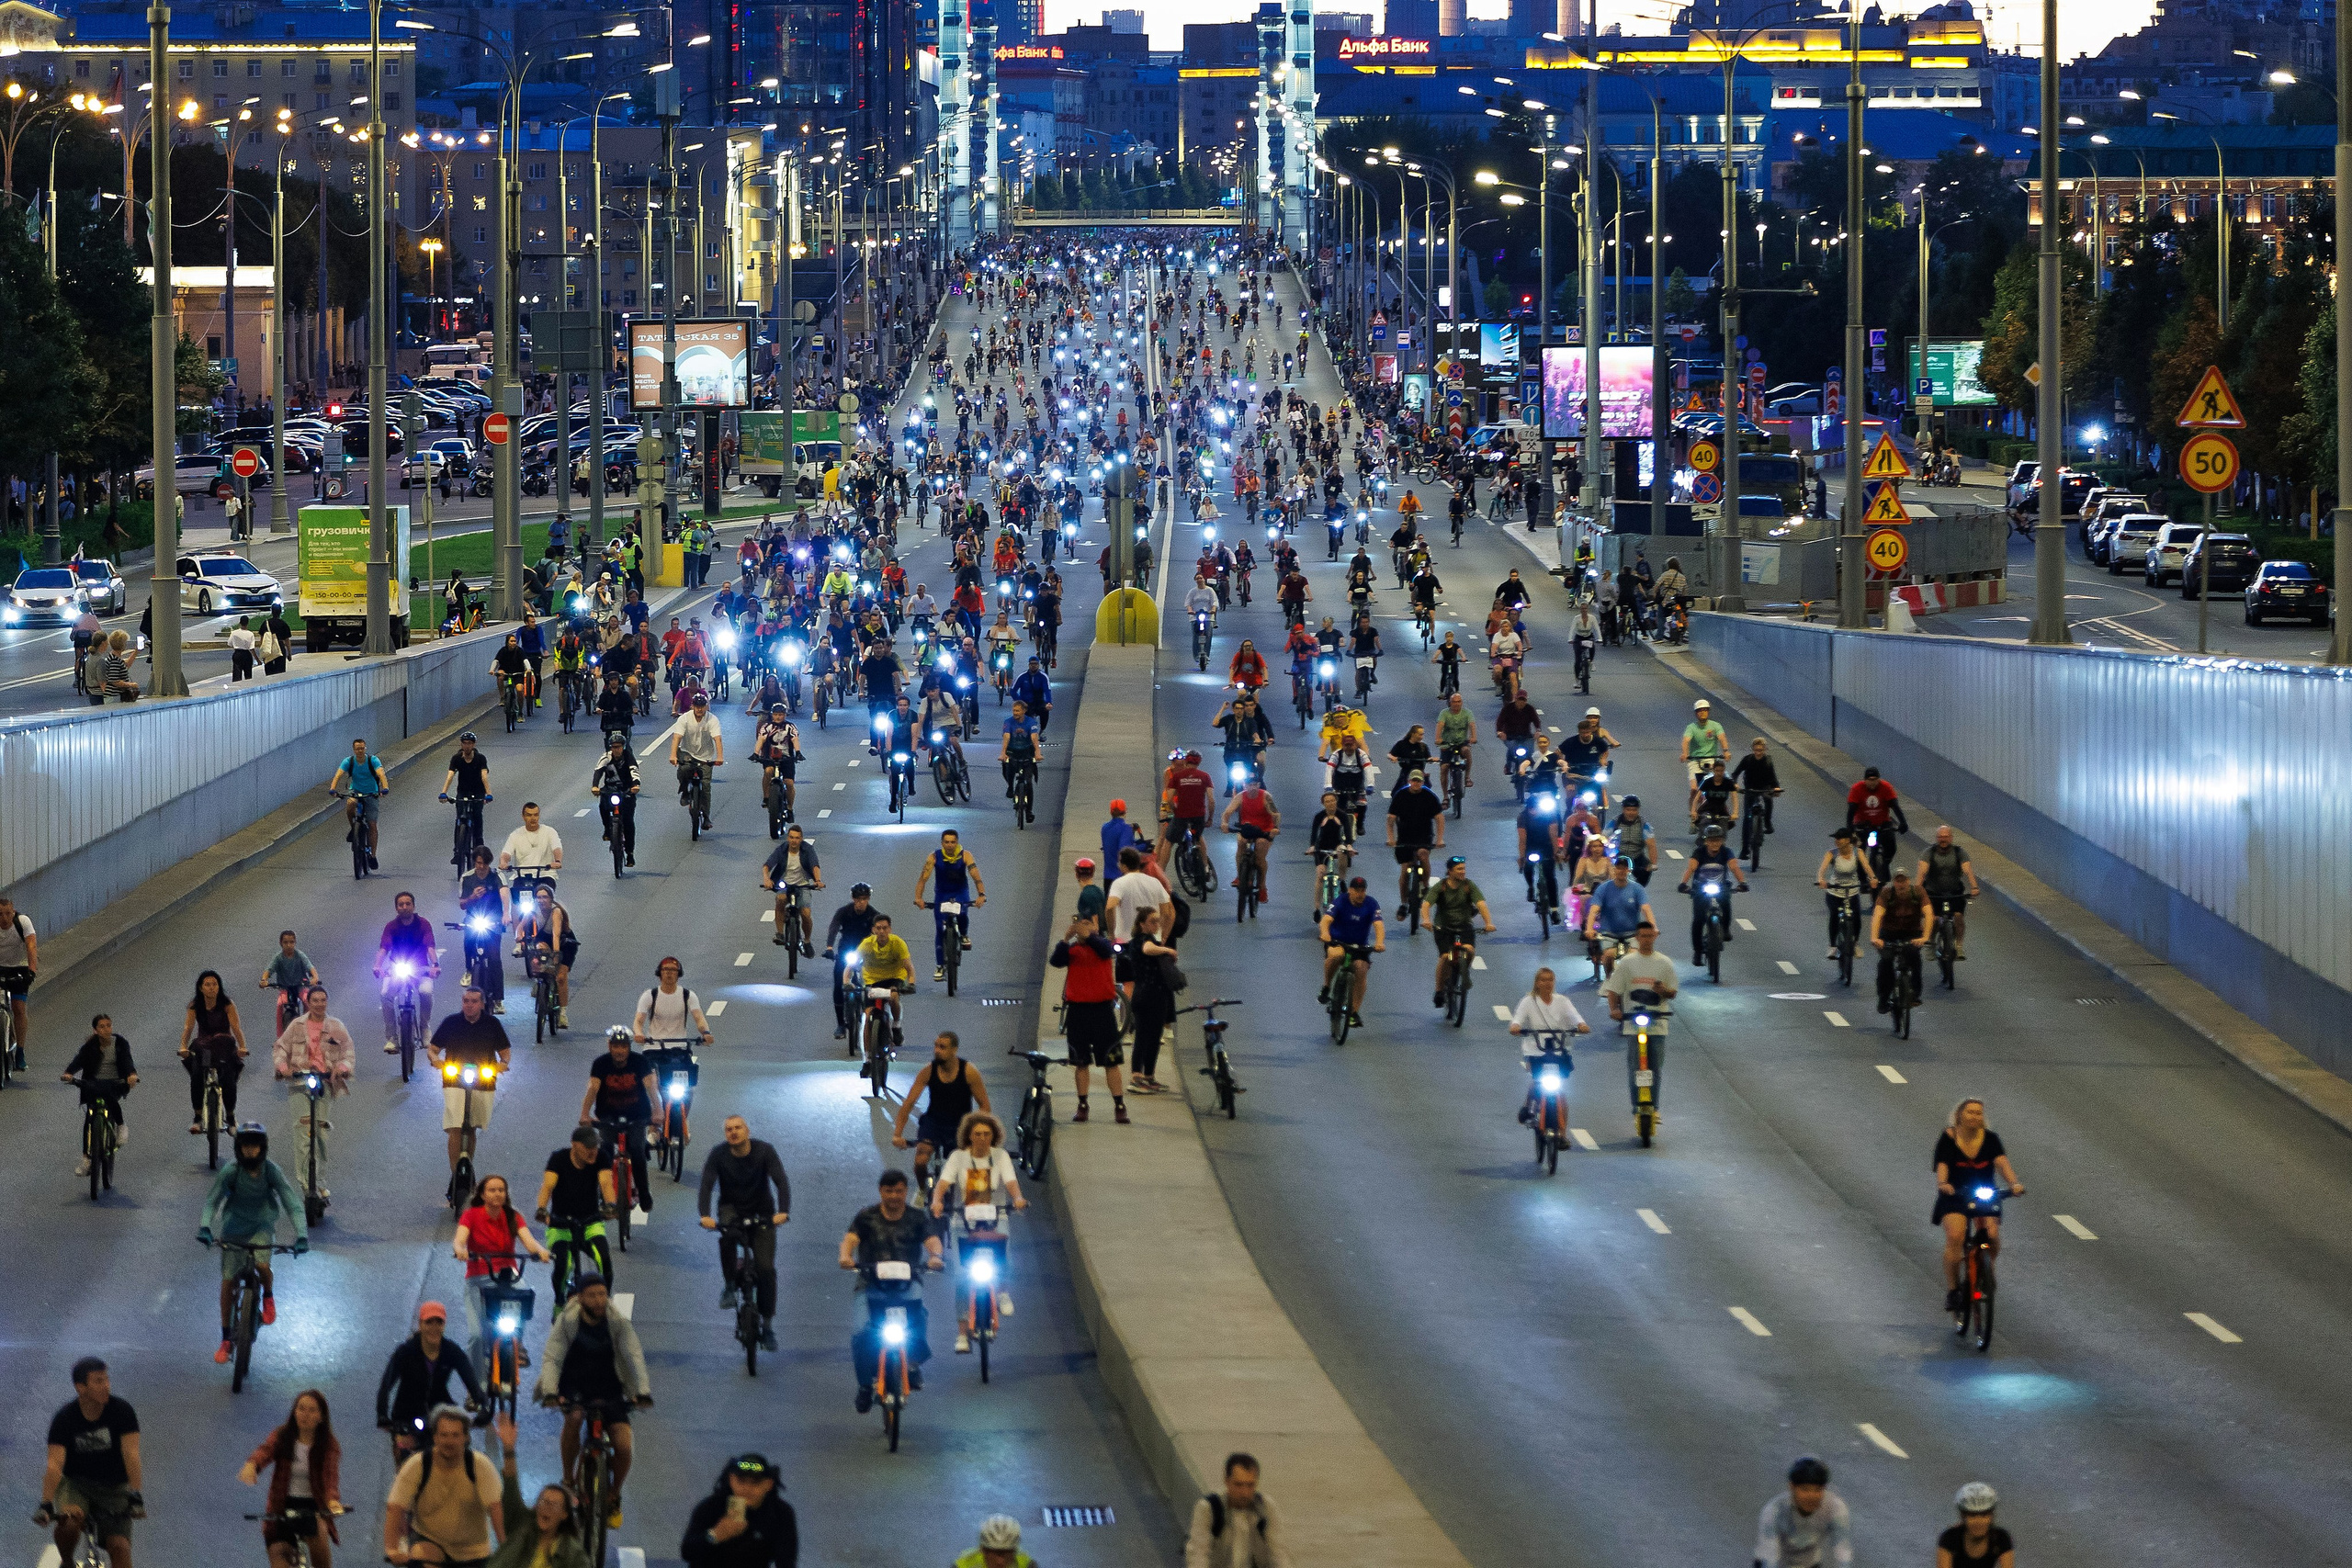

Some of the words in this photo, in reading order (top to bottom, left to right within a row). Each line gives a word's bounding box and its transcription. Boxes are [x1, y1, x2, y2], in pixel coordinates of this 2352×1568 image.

[1016, 45, 1048, 59] Банк
[1340, 38, 1388, 57] Альфа
[1391, 37, 1430, 53] Банк
[637, 333, 720, 342] ТАТРСКАЯ
[723, 333, 740, 341] 35
[1919, 379, 1929, 393] P
[1694, 450, 1713, 463] 40
[2195, 451, 2227, 475] 50
[308, 527, 387, 537] грузовичк
[1874, 541, 1900, 558] 40
